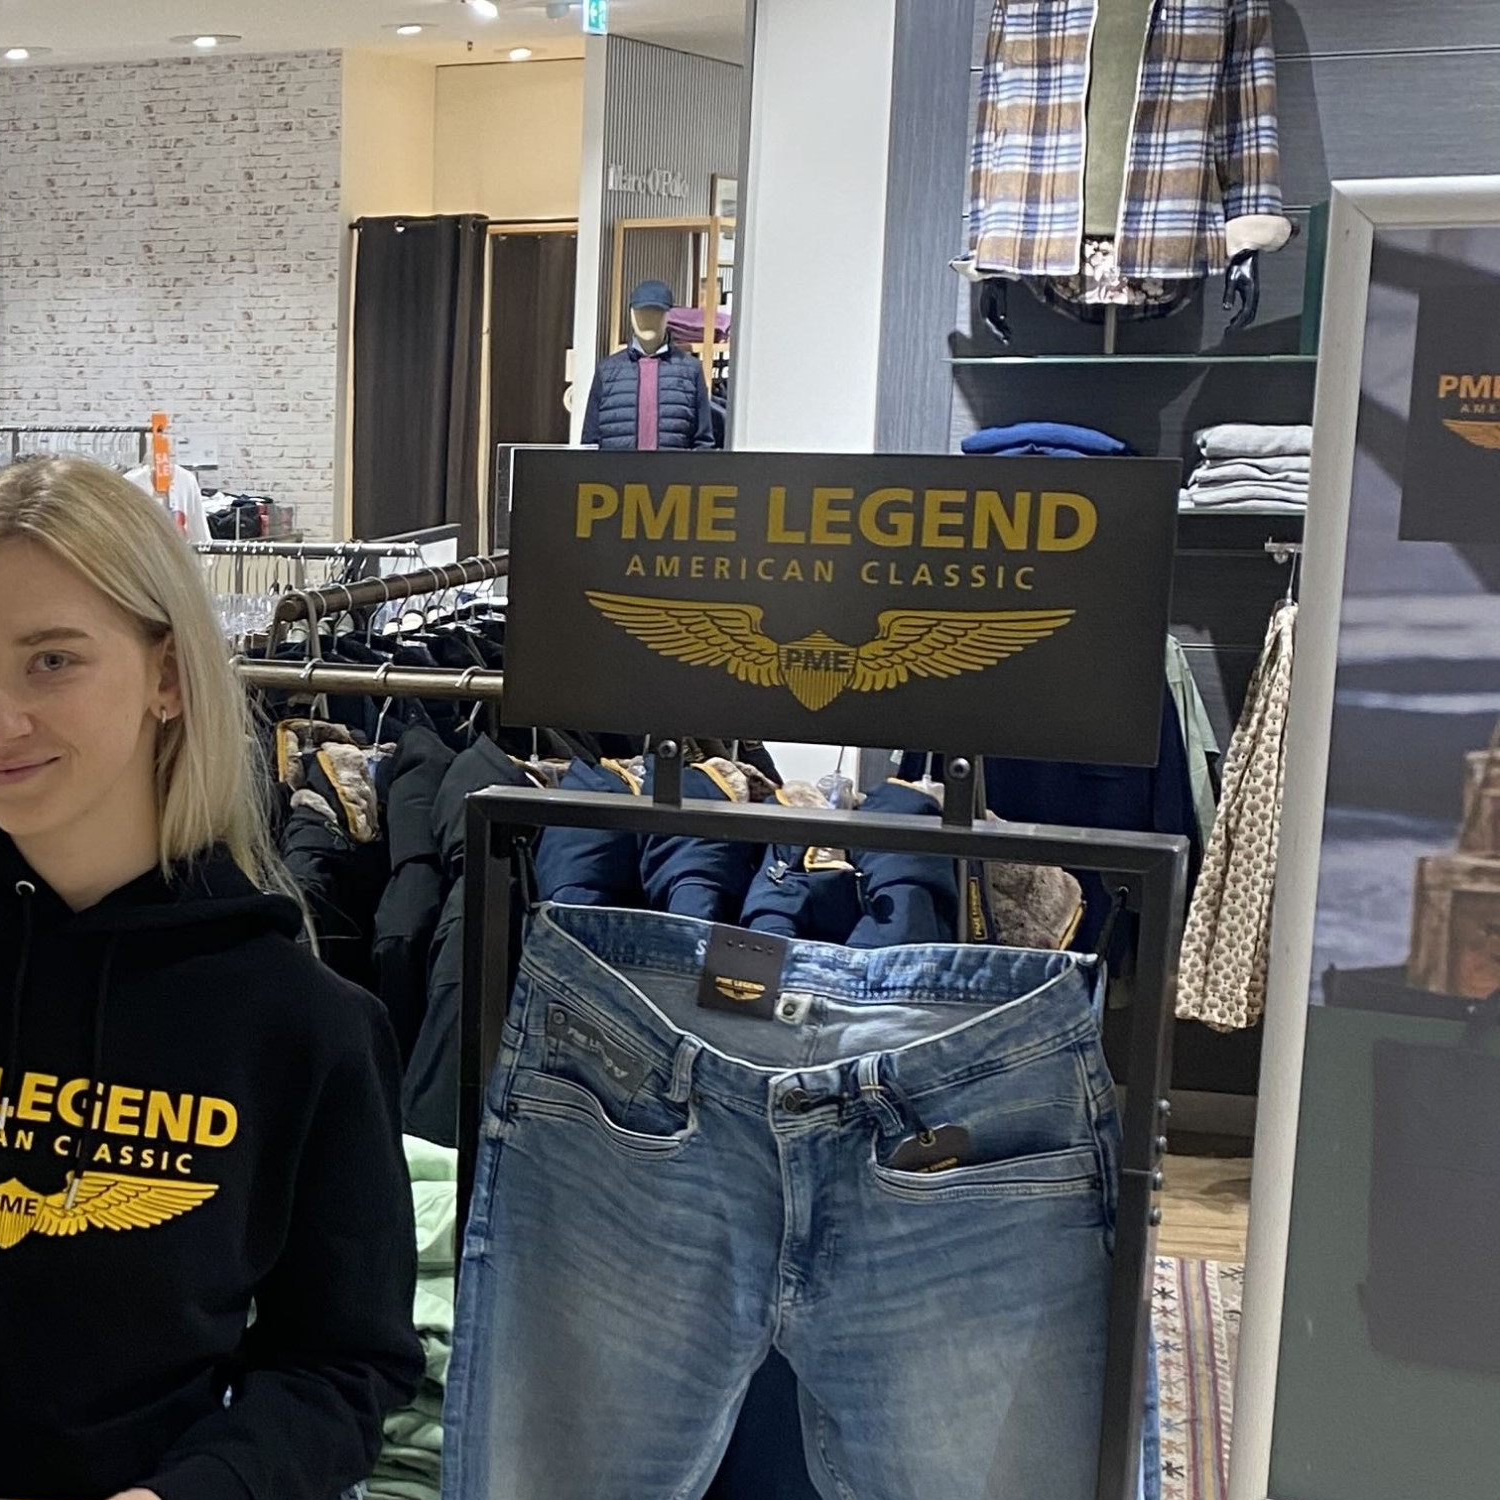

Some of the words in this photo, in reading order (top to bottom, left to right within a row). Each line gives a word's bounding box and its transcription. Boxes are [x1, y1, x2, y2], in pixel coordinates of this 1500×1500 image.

[607, 163, 647, 194] Marc
[575, 482, 740, 543] PME
[765, 486, 1100, 554] LEGEND
[625, 554, 835, 584] AMERICAN
[860, 560, 1036, 591] CLASSIC
[783, 646, 851, 673] PME
[53, 1134, 194, 1175] CASSIC
